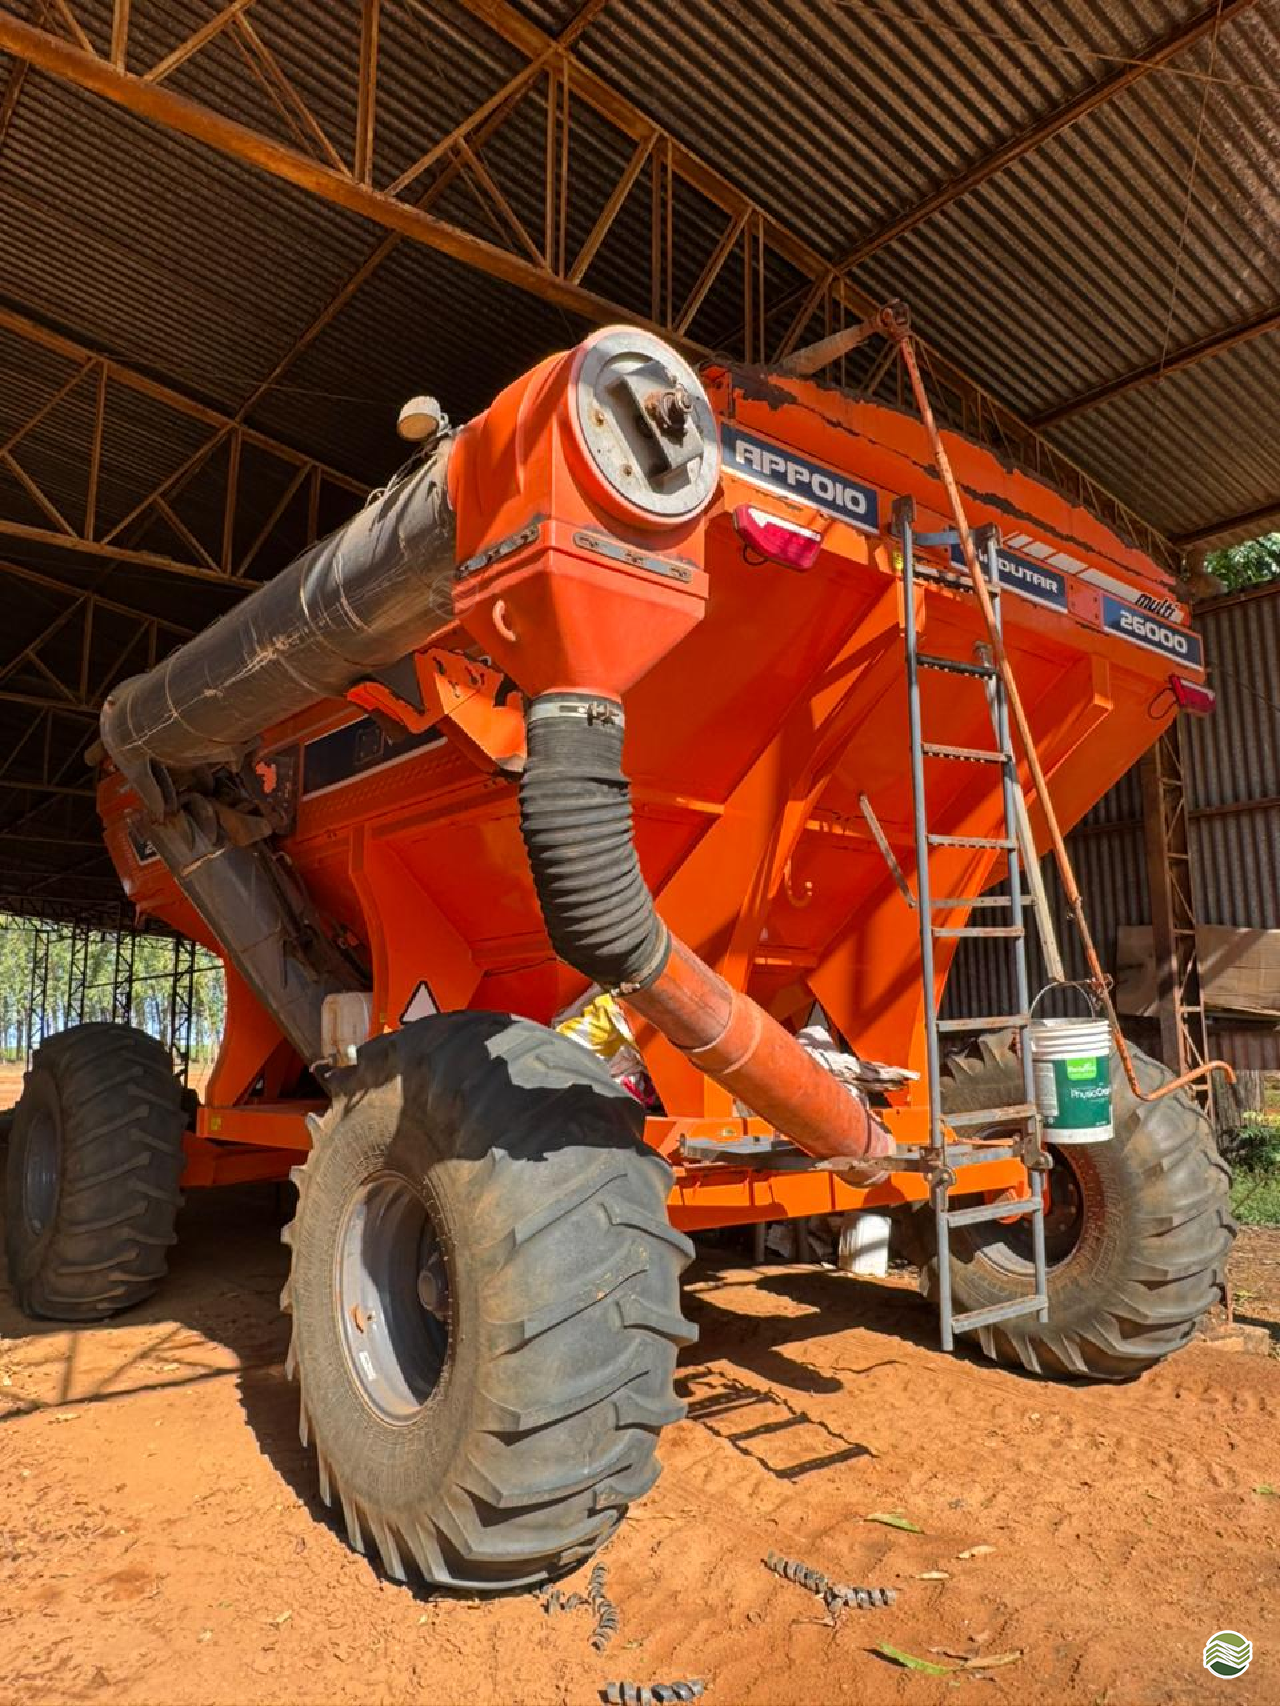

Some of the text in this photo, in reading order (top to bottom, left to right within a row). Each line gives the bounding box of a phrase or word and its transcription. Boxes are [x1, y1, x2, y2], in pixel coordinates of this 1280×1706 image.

[735, 439, 868, 515] APPOIO
[1134, 593, 1177, 618] multi
[1119, 609, 1188, 654] 26000
